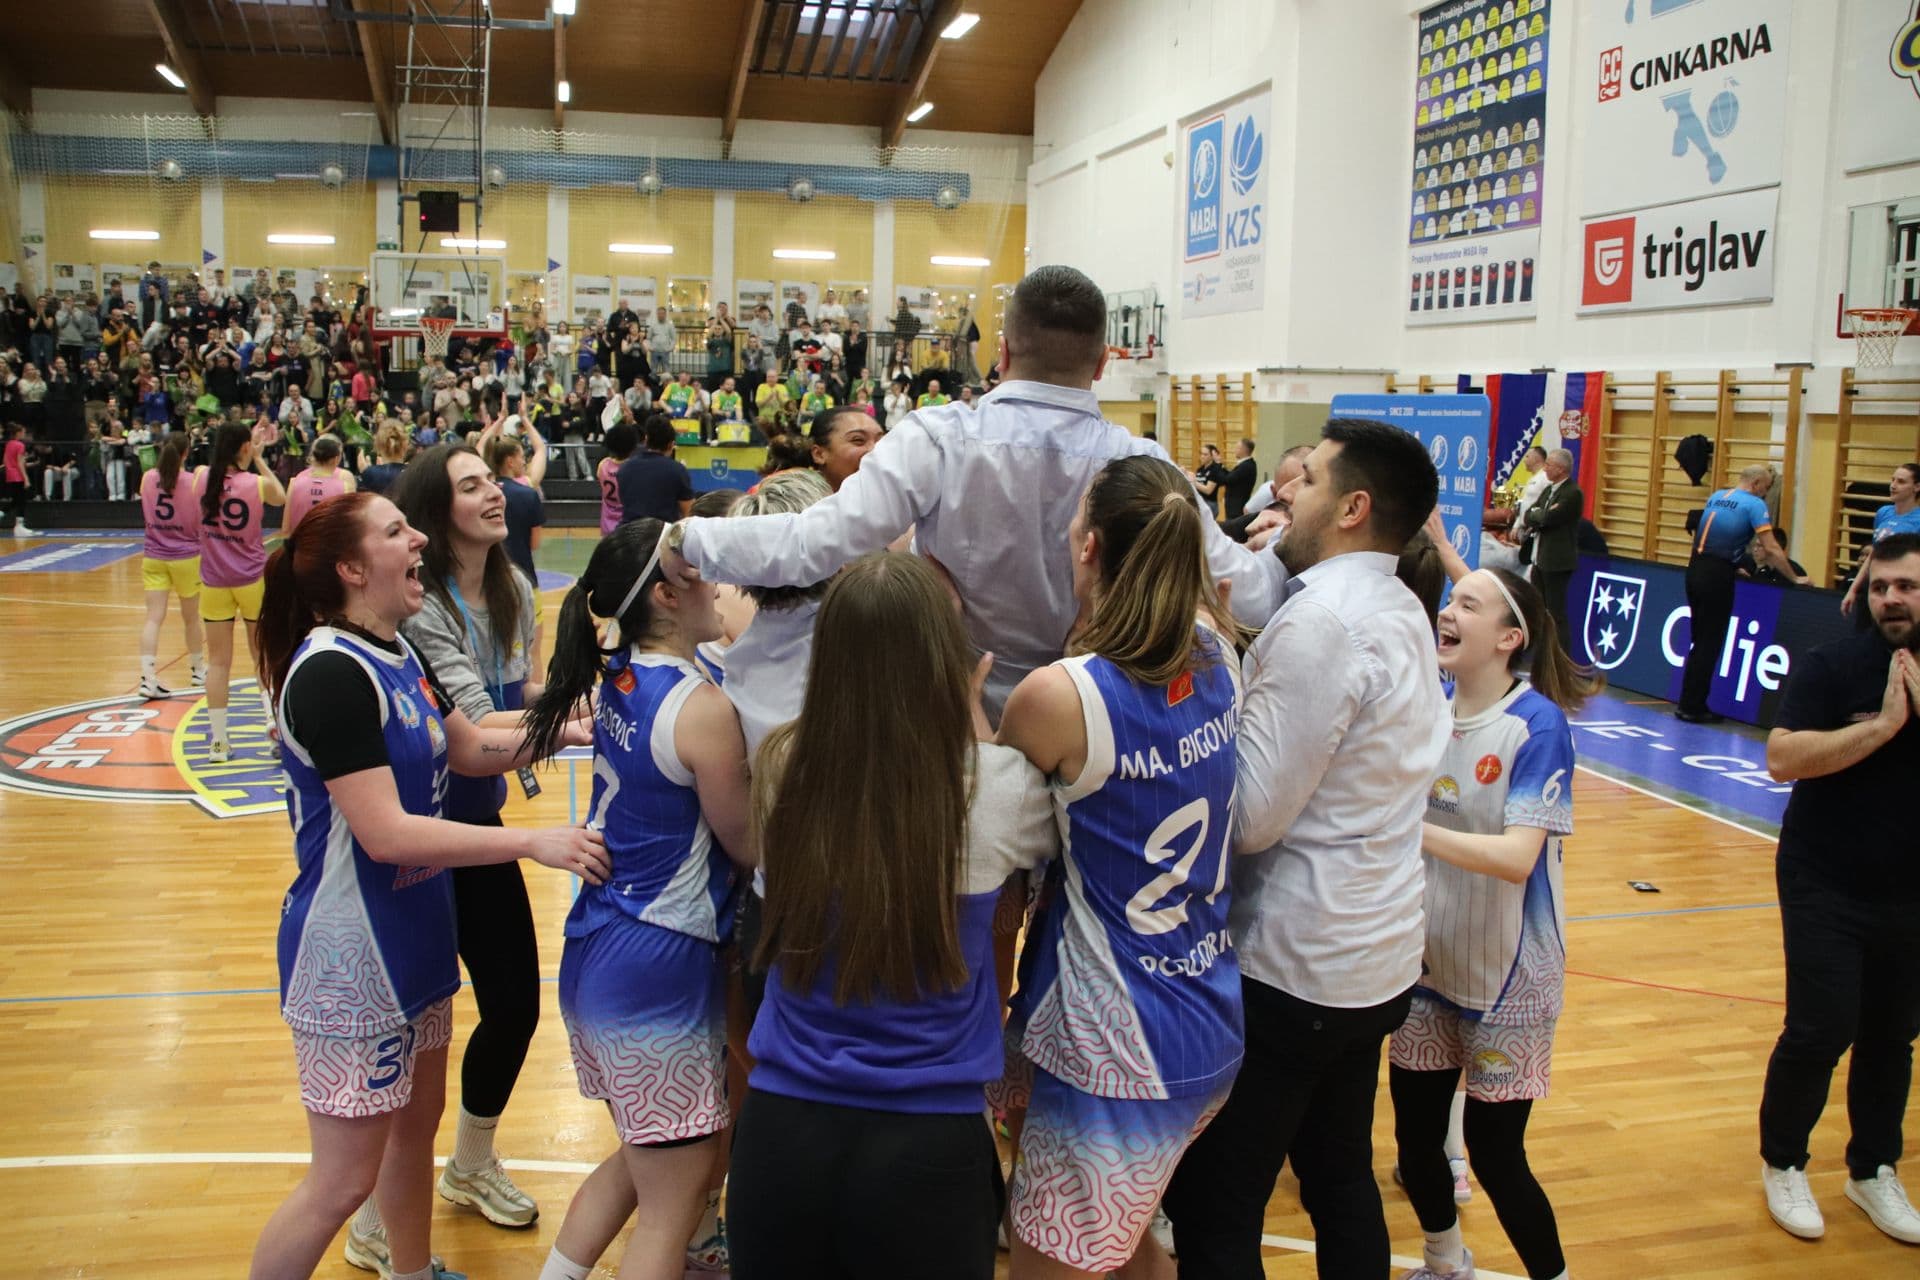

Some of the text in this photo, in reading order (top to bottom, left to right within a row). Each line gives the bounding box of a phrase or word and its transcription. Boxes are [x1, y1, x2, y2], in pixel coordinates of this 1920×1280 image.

[1630, 23, 1772, 91] CINKARNA
[1225, 204, 1261, 250] KZS
[1642, 220, 1767, 291] triglav
[155, 493, 175, 520] 5
[1661, 605, 1790, 702] Clje
[15, 709, 160, 770] CELJE
[1120, 749, 1173, 780] MA.
[1541, 768, 1567, 808] 6
